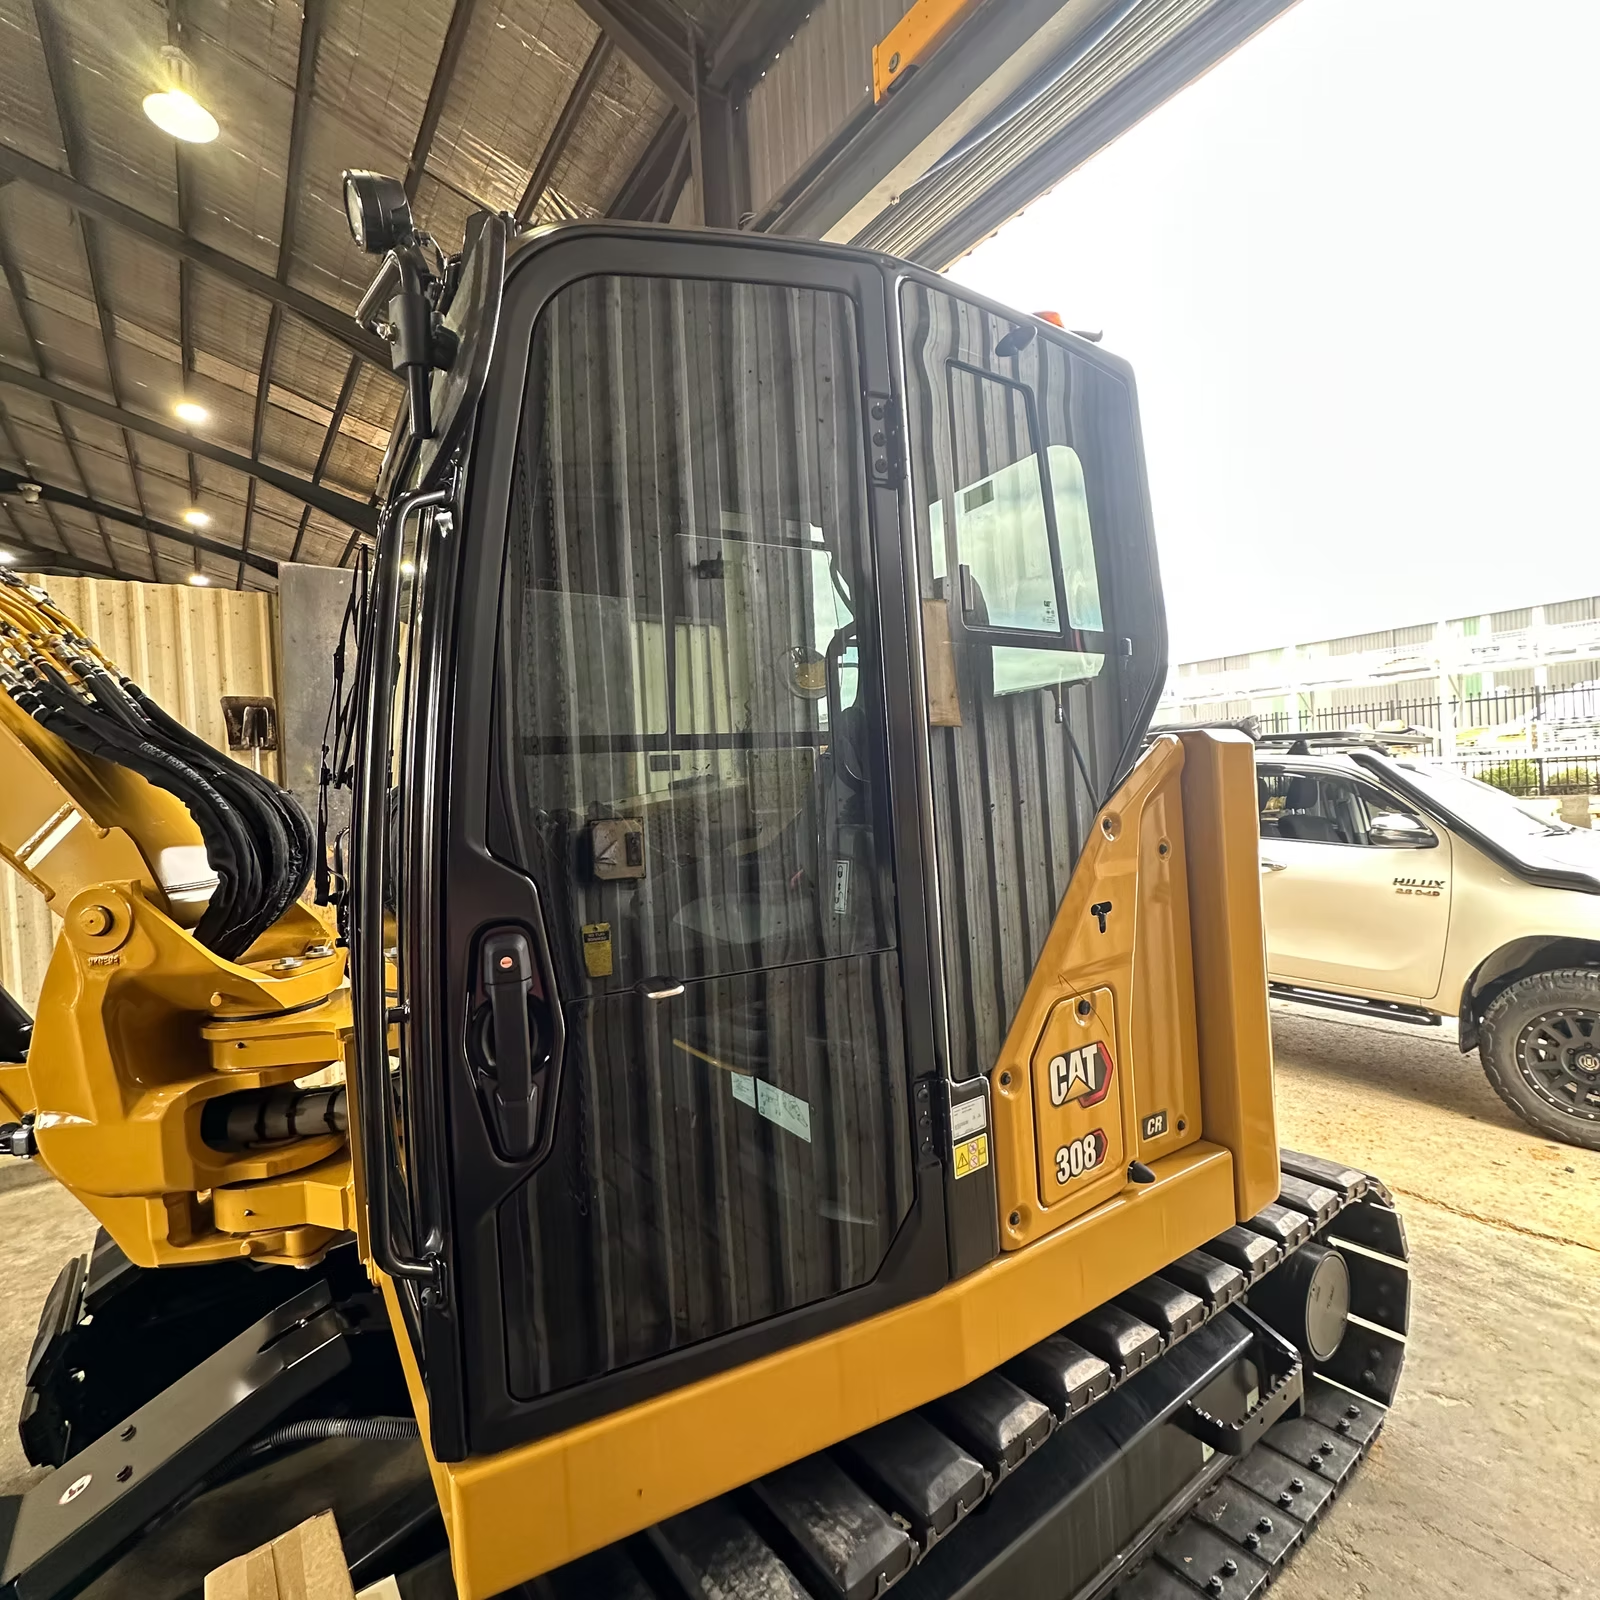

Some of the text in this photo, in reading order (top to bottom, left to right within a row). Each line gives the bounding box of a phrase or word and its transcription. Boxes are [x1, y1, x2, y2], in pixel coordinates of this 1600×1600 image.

[210, 793, 229, 809] CAT
[1392, 877, 1446, 889] HILUX
[1049, 1043, 1098, 1106] CAT
[1146, 1115, 1163, 1136] CR
[1056, 1133, 1097, 1184] 308
